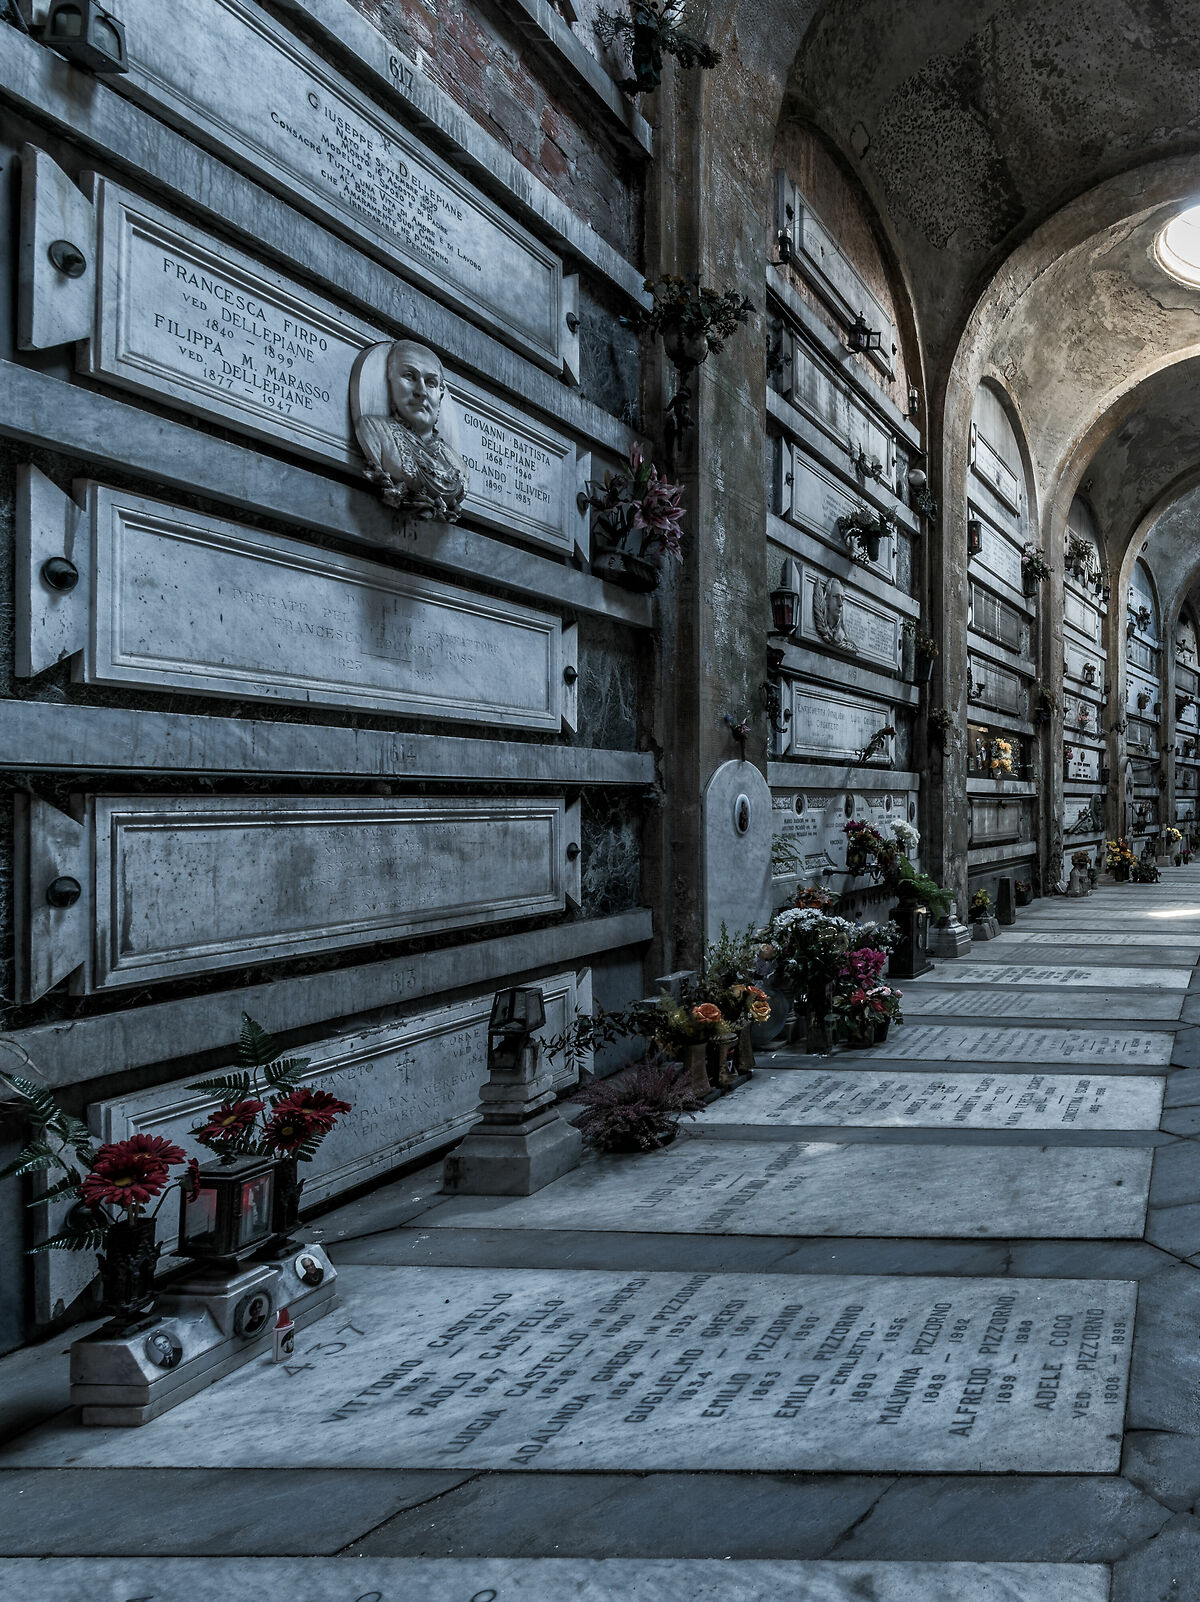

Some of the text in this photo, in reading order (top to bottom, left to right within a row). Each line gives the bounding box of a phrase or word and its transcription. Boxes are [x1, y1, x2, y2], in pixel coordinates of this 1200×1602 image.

[389, 55, 414, 91] 617
[306, 87, 462, 222] GIUSEPPE DELLEPIANE
[162, 256, 327, 353] FRANCESCA FIRPO
[182, 291, 314, 364] VED DELLEPIANE
[205, 315, 293, 371] 1840 1899
[153, 311, 330, 404] FILIPPA M. MARASSO
[178, 345, 313, 411] VED. DELLEPIANE
[202, 365, 292, 416] 1877 1947
[461, 453, 550, 504] ROLANDO ULIVIERI
[463, 410, 550, 466] GIOVANNI BATTISTA
[480, 434, 536, 472] DELLEPIANE
[484, 477, 503, 494] 1899
[319, 1292, 515, 1423] VITTORIO CASTELLO
[390, 1311, 515, 1396] 1851 1897
[404, 1299, 566, 1416] PAOLO CASTELLO
[435, 1408, 508, 1454] LUIGIA
[501, 1332, 591, 1397] CASTELLO
[596, 1277, 651, 1313] GHERSI
[462, 1312, 576, 1398] 1847 1901
[504, 1392, 597, 1464] ADALINDA
[587, 1339, 648, 1382] GHERSI
[650, 1273, 713, 1321] PIZZORNO
[533, 1313, 637, 1399] 1838 1900
[604, 1314, 699, 1400] 1864 1932
[620, 1298, 749, 1423] GUGLIELMO GHERSI
[675, 1315, 760, 1400] 1834 1901
[698, 1303, 805, 1418] EMILIO PIZZORNO
[747, 1315, 821, 1401] 1863 1960
[772, 1304, 866, 1419] EMILIO PIZZORNO
[875, 1301, 953, 1425] MALVINA PIZZORNO
[881, 1317, 908, 1342] 1956
[946, 1295, 1016, 1438] ALFREDO PIZZORNO
[995, 1319, 1034, 1403] 1899 1988
[1032, 1314, 1074, 1412] ADELE COCO
[1075, 1307, 1106, 1371] PIZZORNO
[921, 1373, 947, 1403] 1889
[1102, 1375, 1121, 1404] 1908
